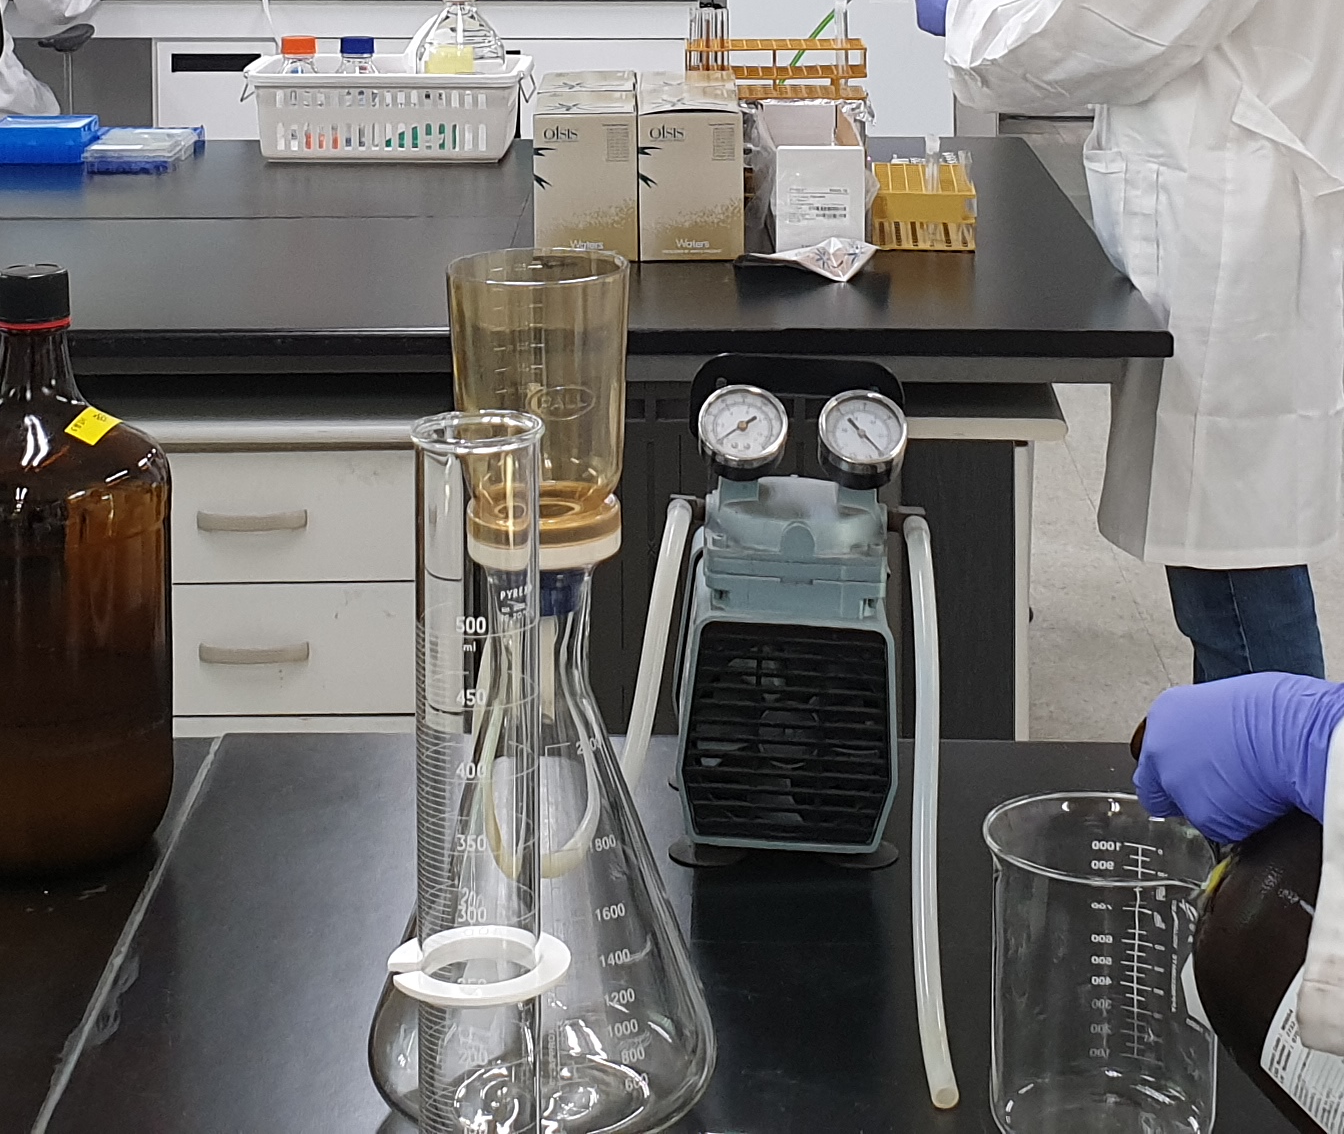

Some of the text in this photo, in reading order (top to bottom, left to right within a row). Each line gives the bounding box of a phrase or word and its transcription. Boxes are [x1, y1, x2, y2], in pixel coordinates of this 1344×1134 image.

[675, 238, 710, 248] Waters
[456, 616, 487, 634] 500
[462, 642, 476, 653] ml
[456, 689, 487, 706] 450
[456, 762, 487, 779] 400
[456, 834, 487, 851] 350
[457, 905, 487, 924] 300
[595, 902, 626, 921] 1600
[600, 948, 630, 967] 1400
[604, 987, 635, 1006] 1200
[608, 1019, 638, 1037] 1000
[621, 1047, 645, 1064] 800
